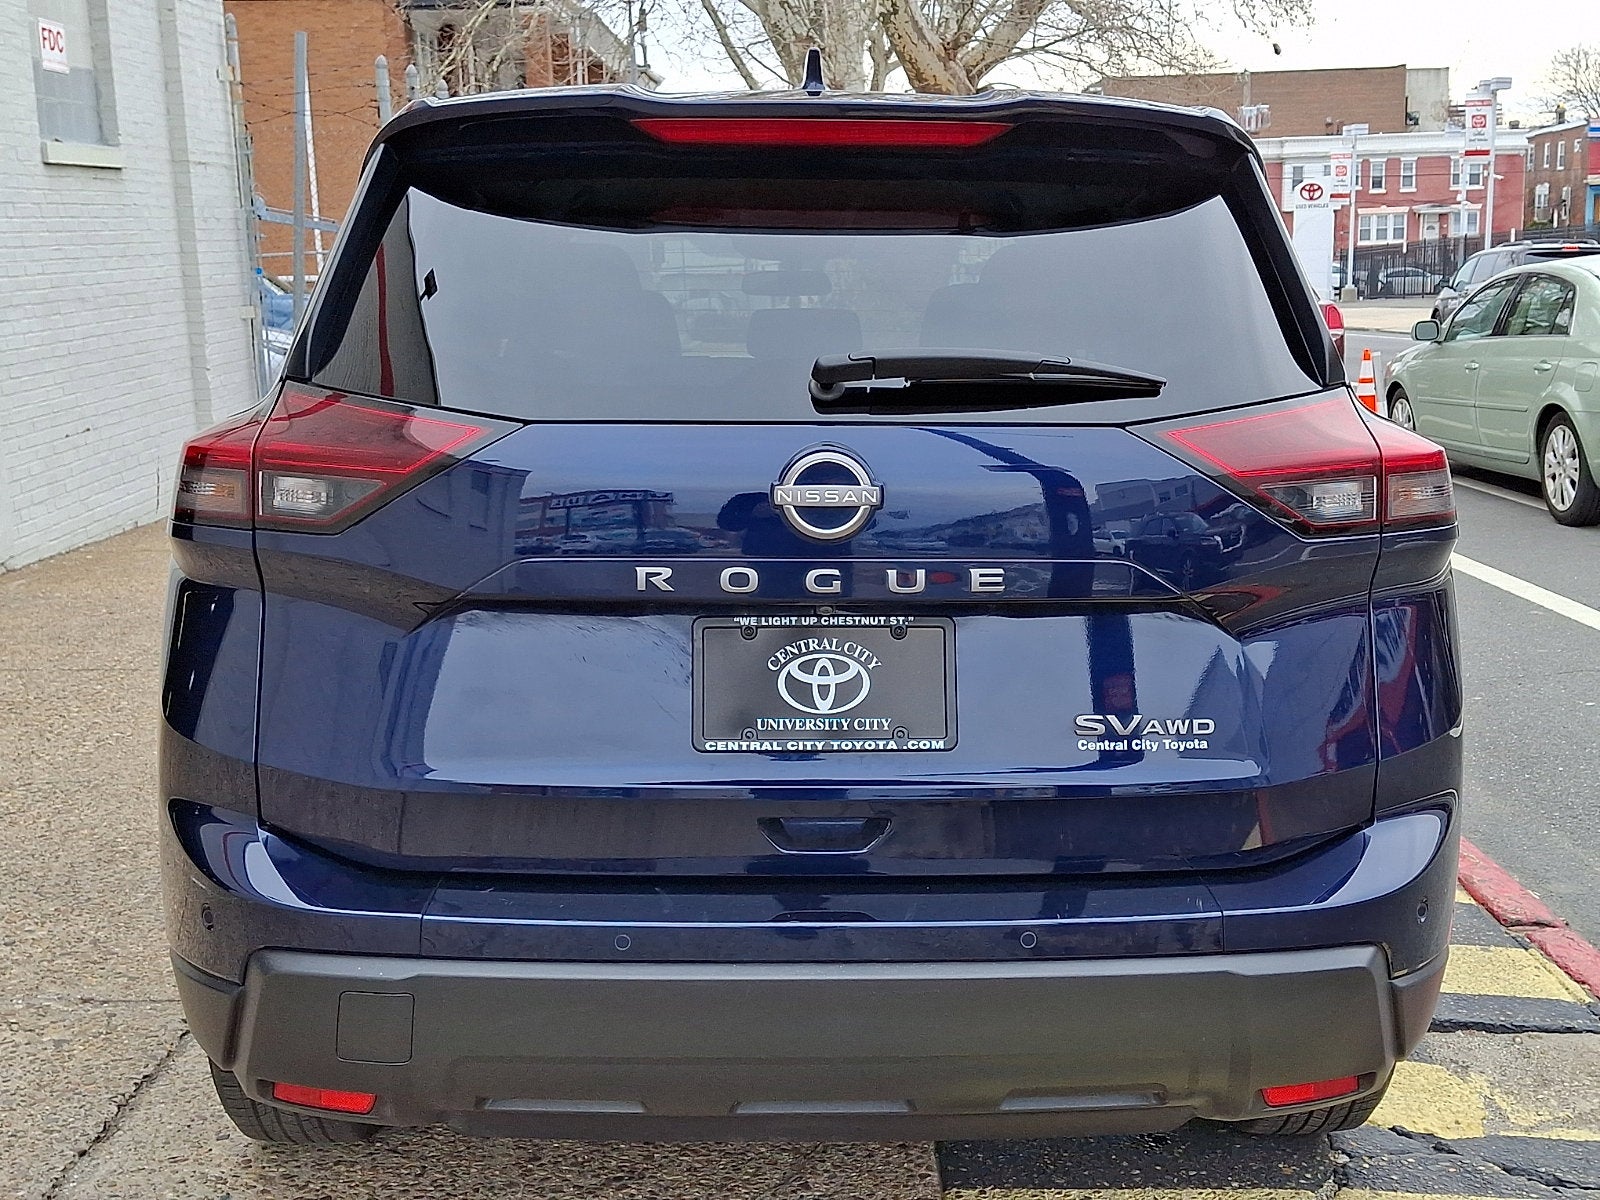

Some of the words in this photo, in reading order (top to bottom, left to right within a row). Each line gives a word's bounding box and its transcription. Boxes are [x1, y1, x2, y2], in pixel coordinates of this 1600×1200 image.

[41, 27, 64, 53] FDC
[776, 489, 878, 503] NISSAN
[635, 566, 1007, 594] ROGUE
[761, 616, 795, 626] LIGHT
[800, 616, 818, 626] UP
[821, 616, 886, 626] CHESTNUT
[767, 637, 842, 672] CENTRAL
[843, 641, 882, 671] CITY
[756, 717, 852, 731] UNIVERSITY
[854, 717, 892, 731] CITY
[704, 740, 783, 751] CENTRAL
[786, 740, 826, 751] CITY
[830, 740, 898, 750] TOYOTA
[903, 739, 945, 750] .COM
[1077, 739, 1128, 751] Central
[1131, 739, 1159, 752] City
[1163, 738, 1209, 752] Toyota
